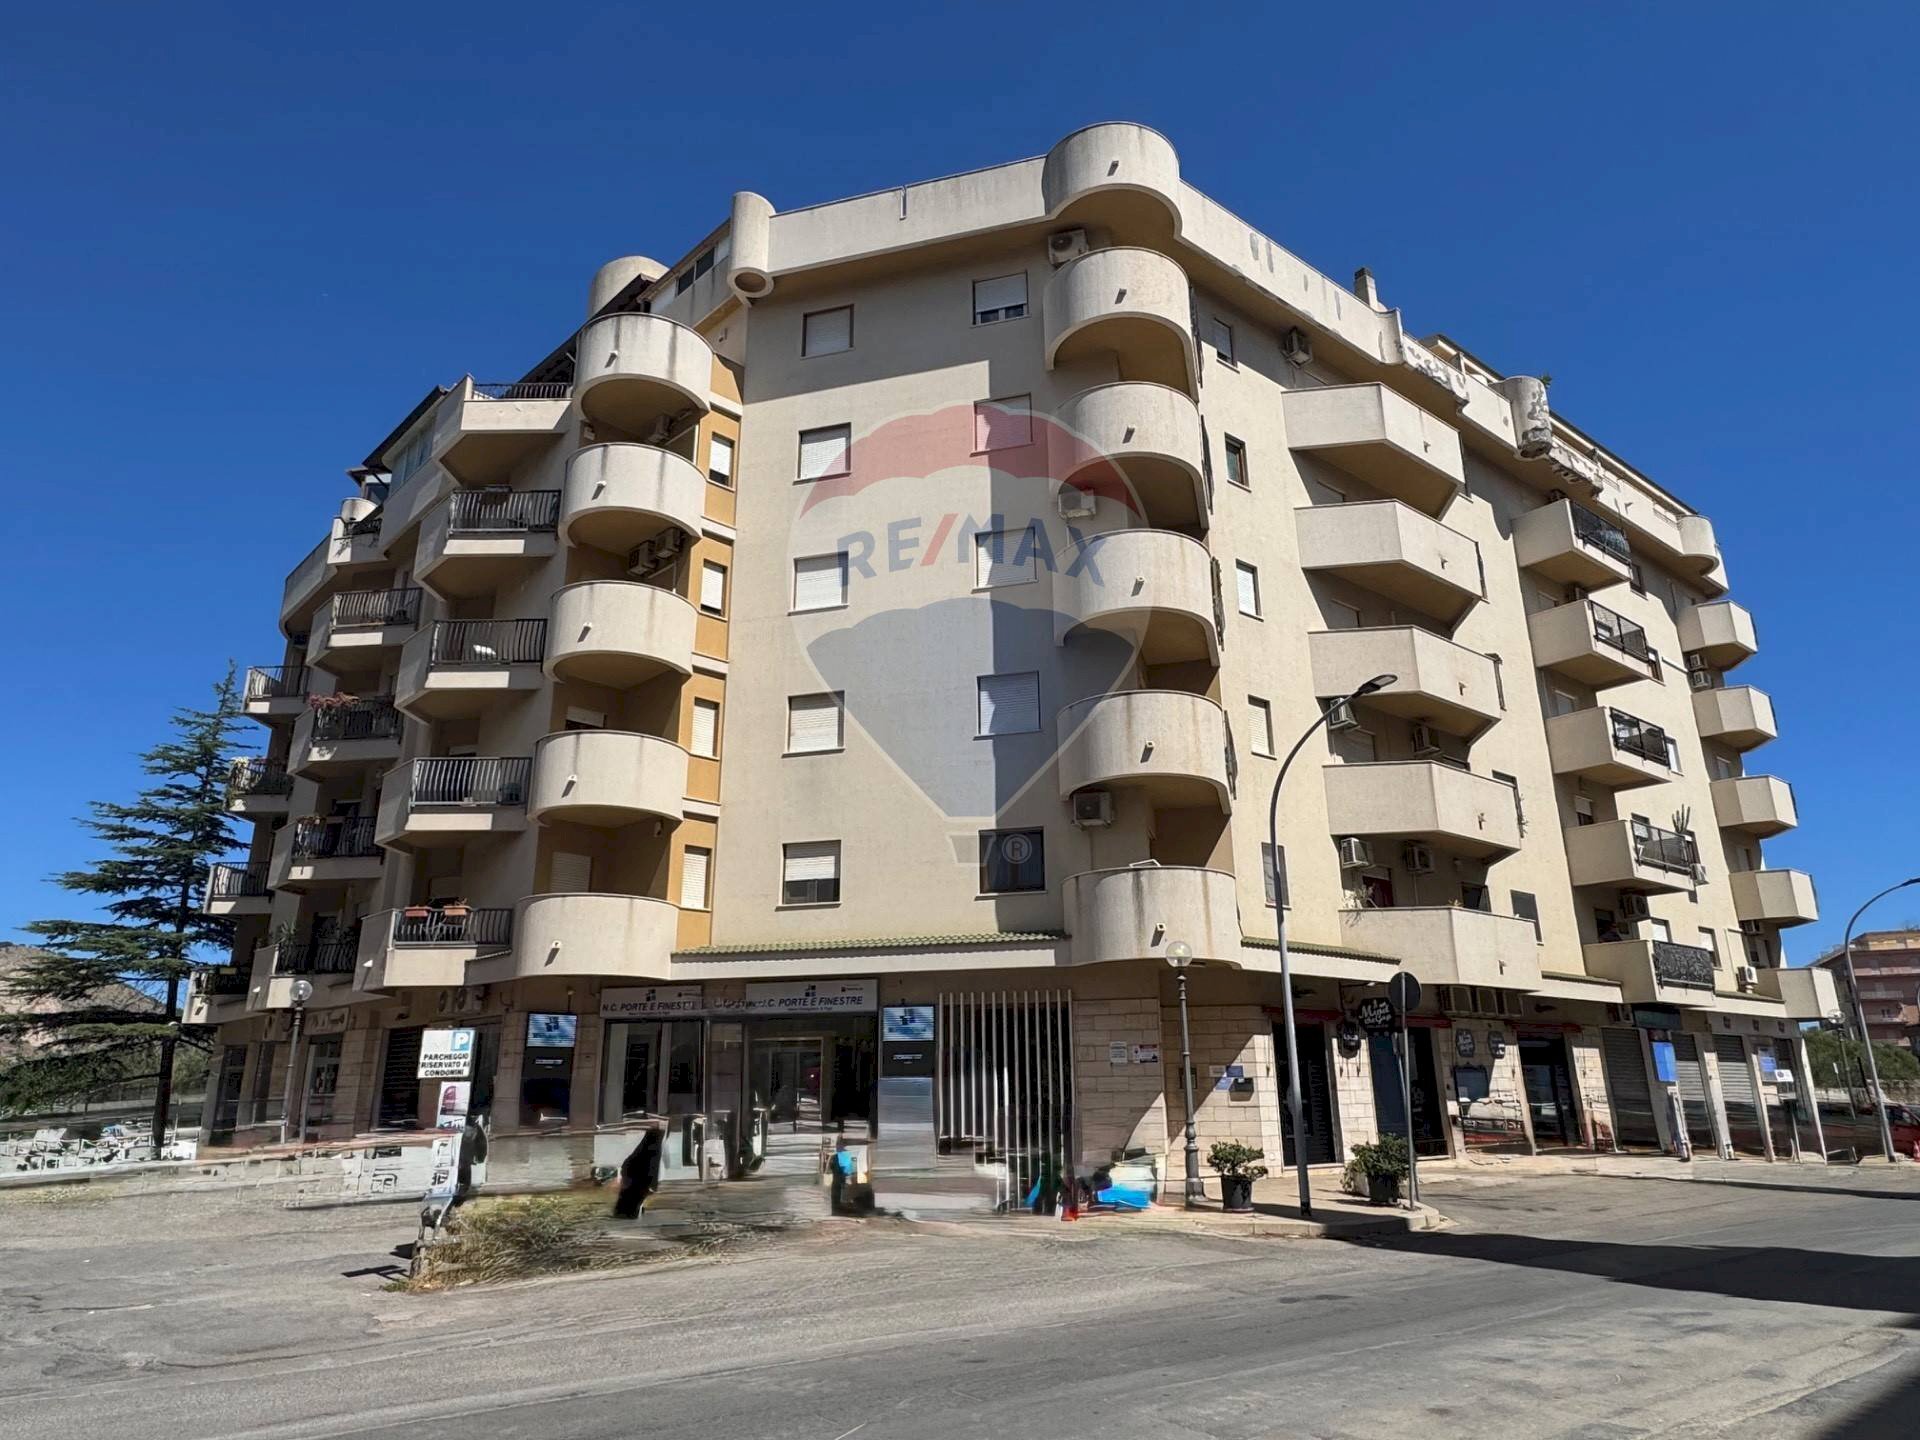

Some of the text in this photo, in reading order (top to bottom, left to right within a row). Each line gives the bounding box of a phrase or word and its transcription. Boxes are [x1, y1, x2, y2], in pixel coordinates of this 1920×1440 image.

[778, 998, 808, 1007] PORTE
[810, 998, 817, 1006] E
[818, 996, 863, 1006] FINESTRE
[620, 1002, 648, 1012] PORTE
[454, 1032, 469, 1050] P
[420, 1061, 461, 1069] RISERVATO
[424, 1069, 464, 1077] CONDOMINI
